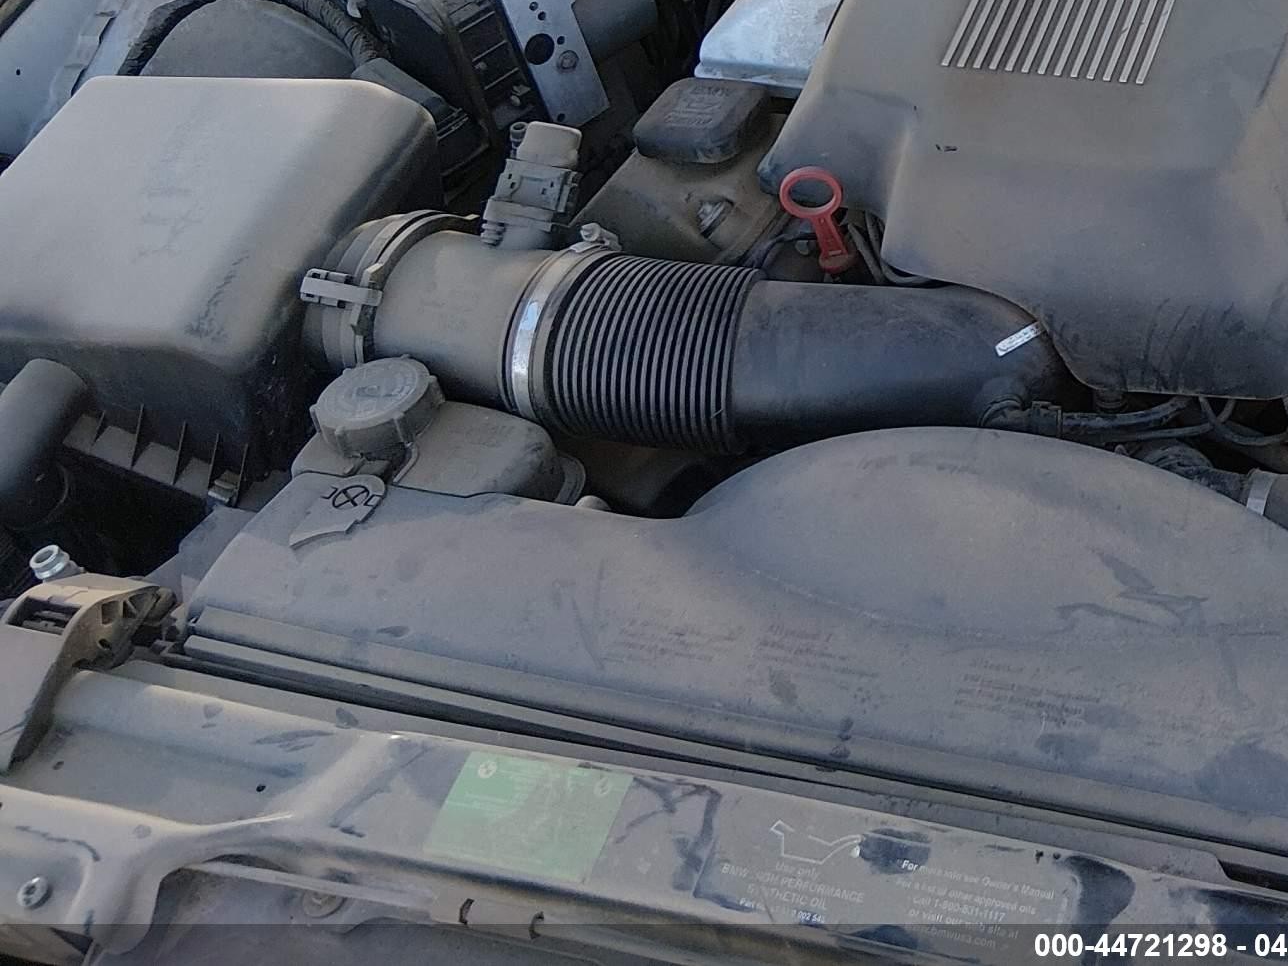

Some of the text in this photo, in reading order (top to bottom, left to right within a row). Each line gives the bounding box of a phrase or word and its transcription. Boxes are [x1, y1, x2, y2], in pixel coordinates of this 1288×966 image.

[721, 863, 749, 878] BMW
[781, 876, 865, 903] PERFORMANCE
[900, 859, 918, 872] For
[1020, 883, 1054, 900] Manual
[810, 896, 828, 911] OIL
